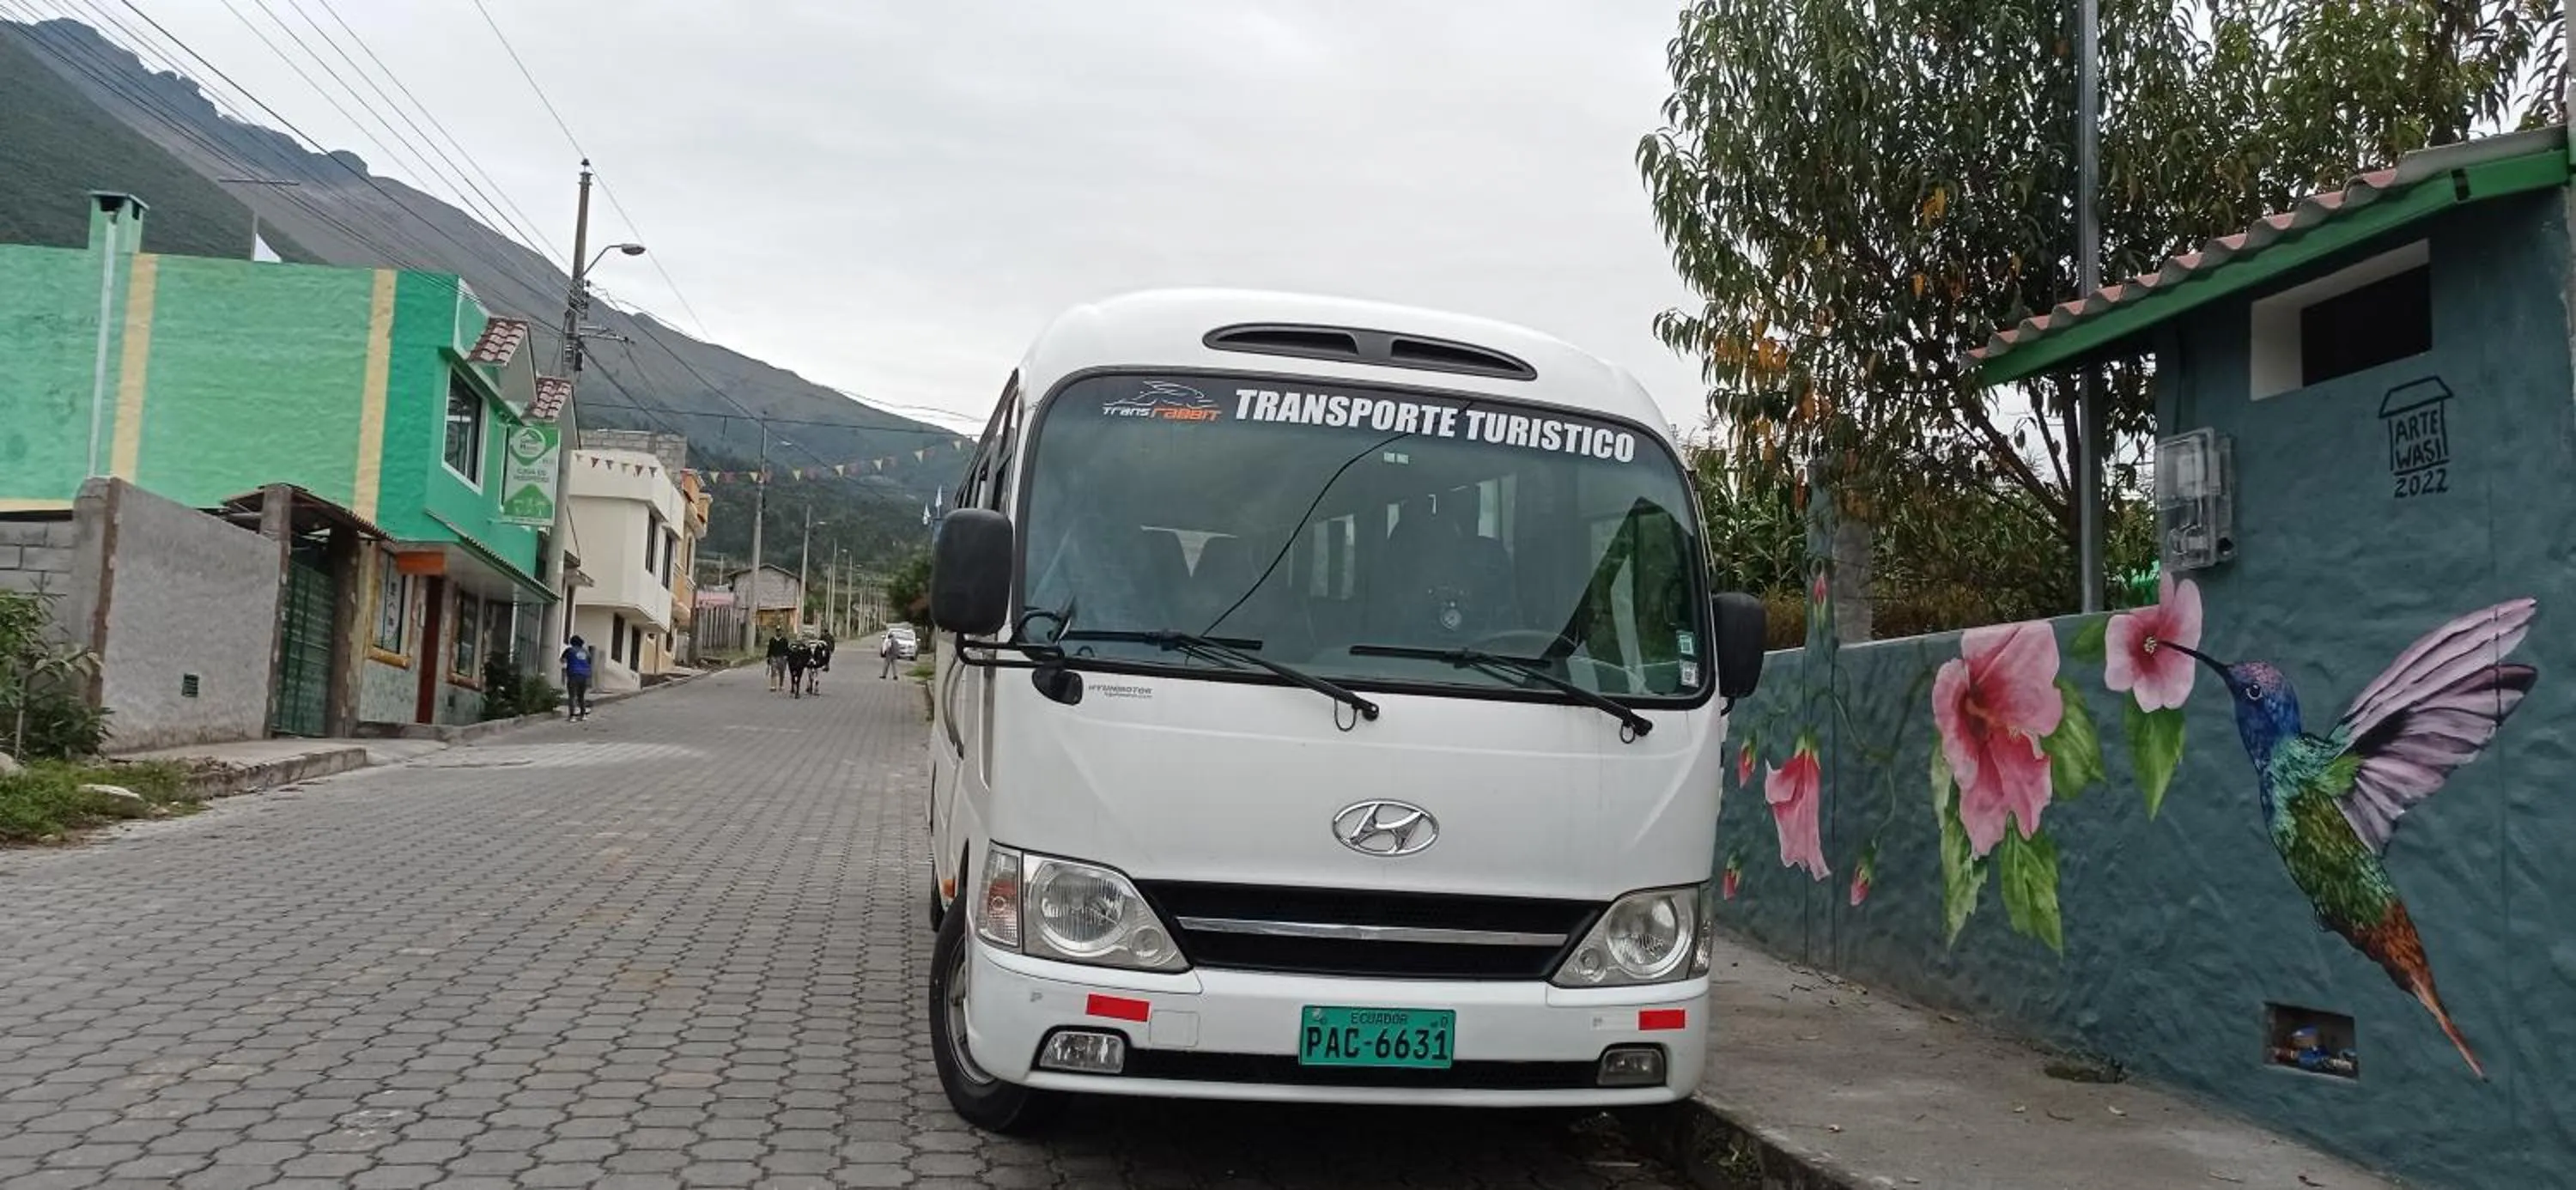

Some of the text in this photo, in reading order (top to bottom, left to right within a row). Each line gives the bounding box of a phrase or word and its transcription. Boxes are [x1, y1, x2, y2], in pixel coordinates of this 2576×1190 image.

[1236, 389, 1636, 463] TRANSPORTE TURISTICO
[2395, 410, 2439, 445] ARTE
[2396, 438, 2441, 470] WASI
[2394, 468, 2449, 499] 2022
[1350, 1011, 1409, 1025] ECUADOR
[1305, 1026, 1449, 1060] PAC-6631
